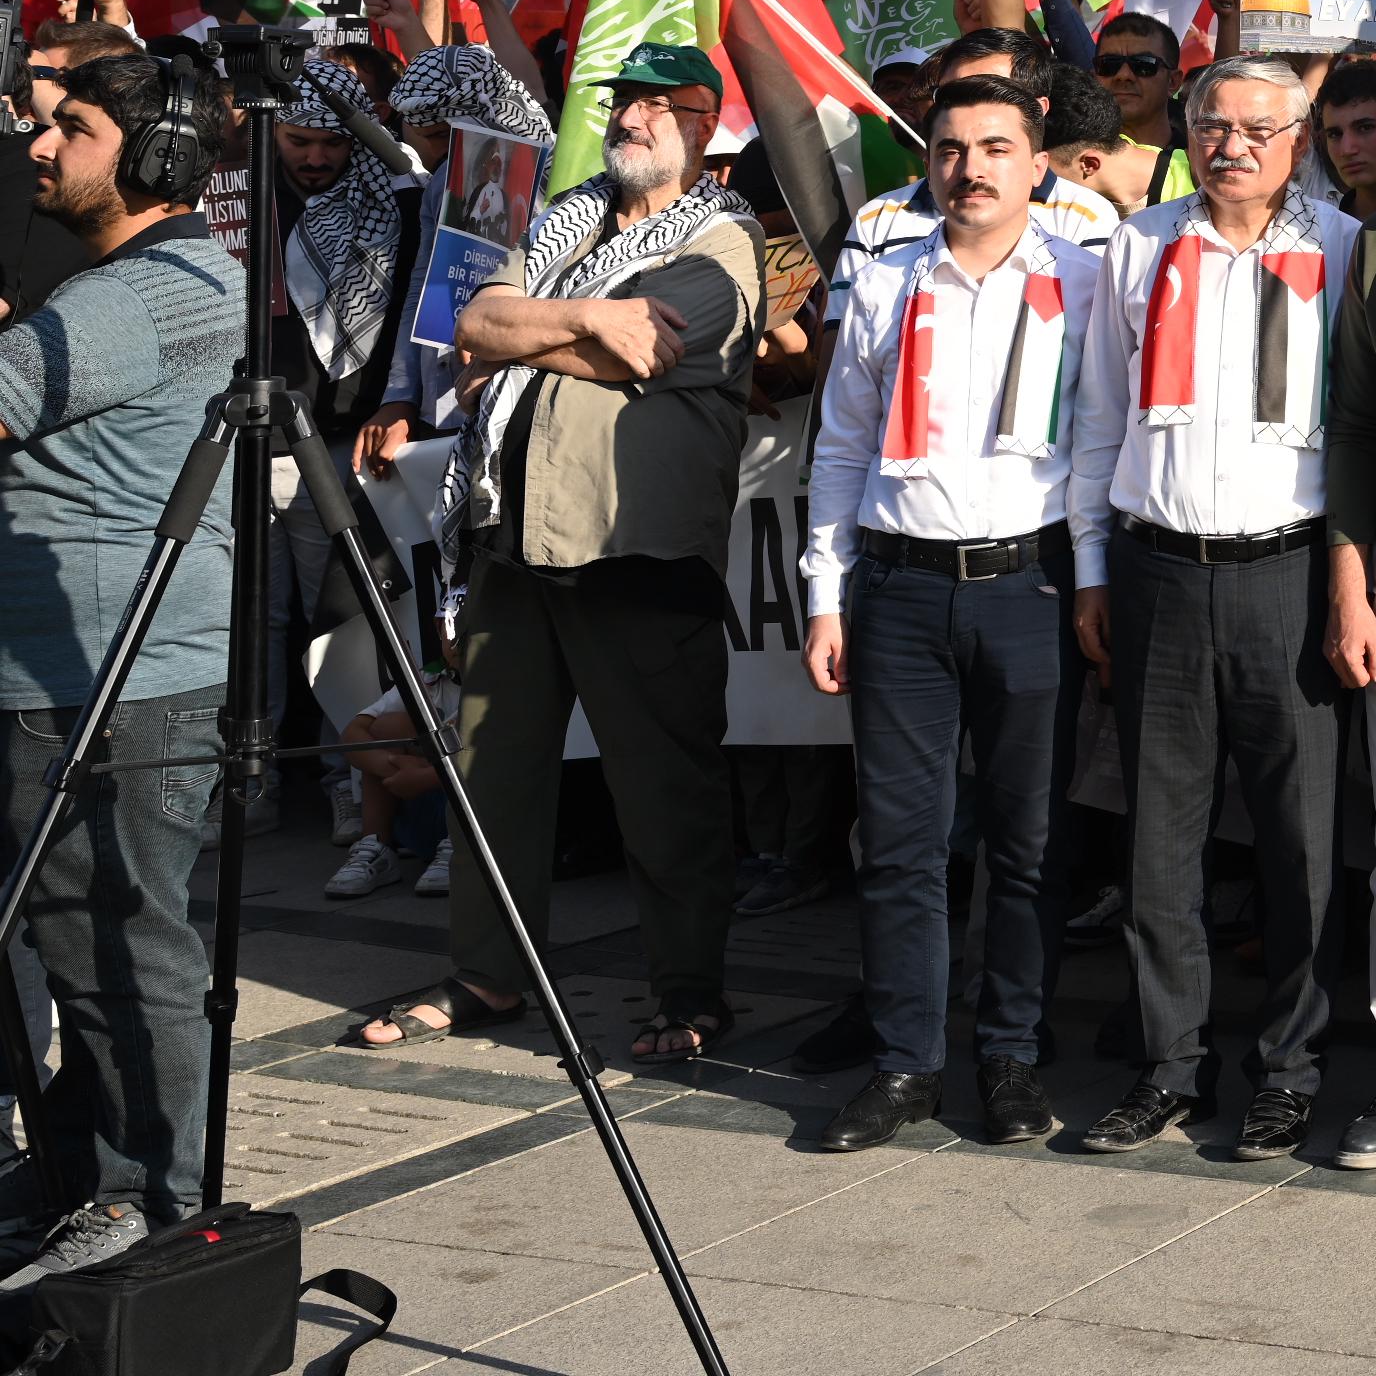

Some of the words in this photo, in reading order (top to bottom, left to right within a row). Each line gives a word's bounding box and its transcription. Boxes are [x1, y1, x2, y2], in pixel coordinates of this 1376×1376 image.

[1318, 0, 1354, 21] EY
[204, 194, 247, 224] İLİSTİN
[447, 264, 466, 281] BİR
